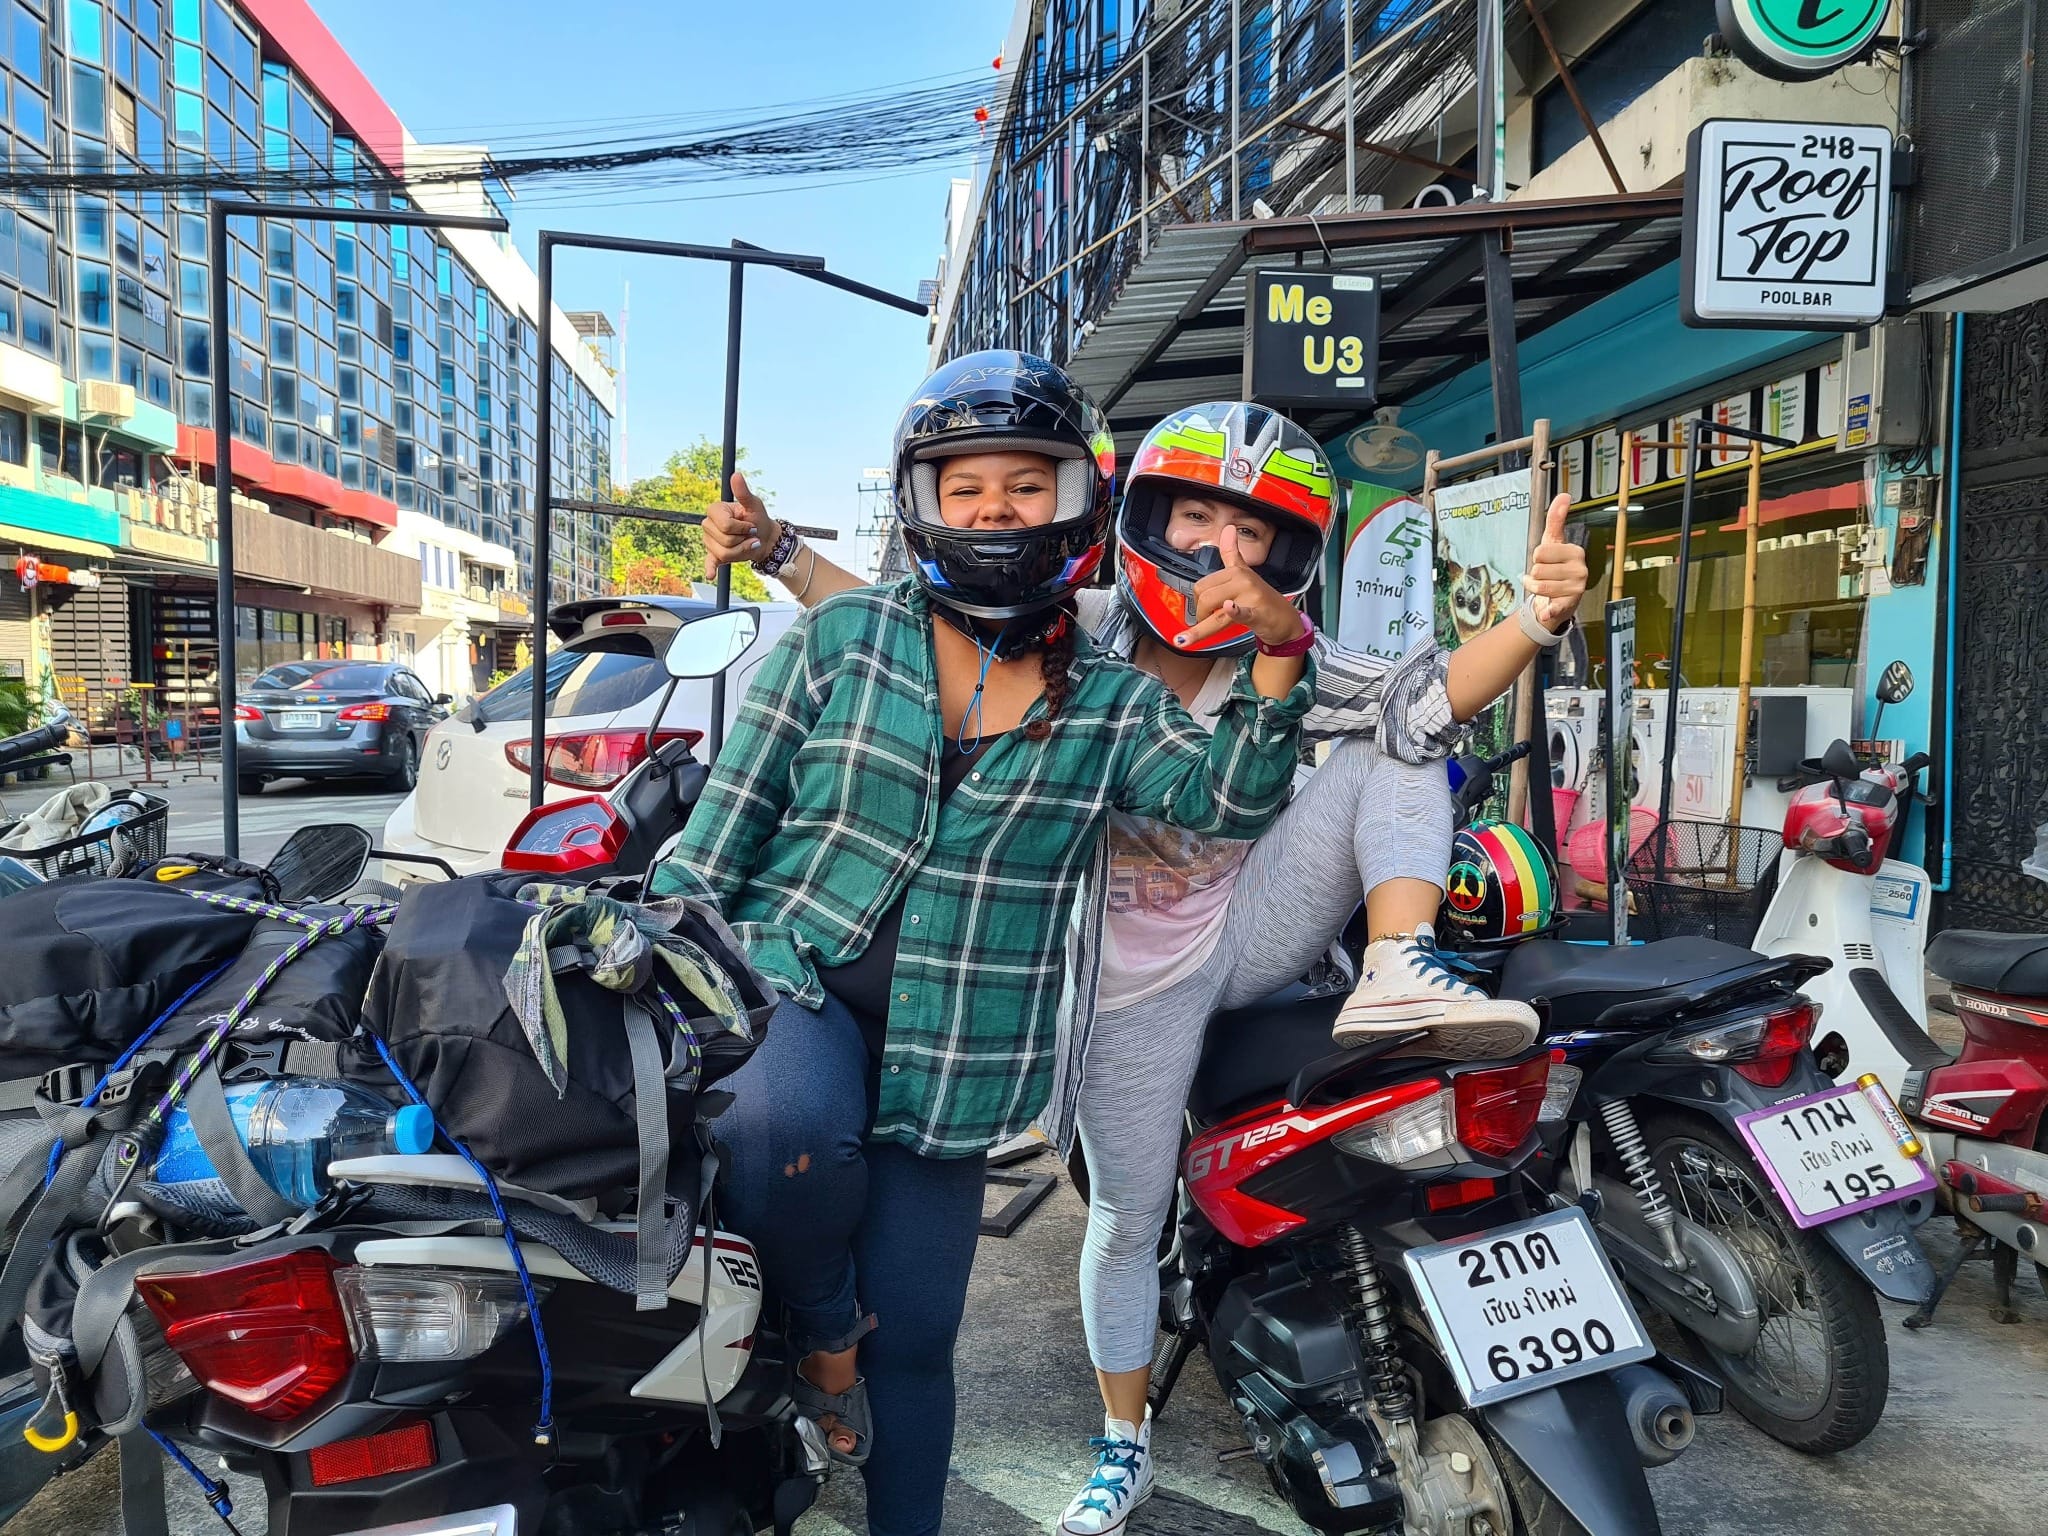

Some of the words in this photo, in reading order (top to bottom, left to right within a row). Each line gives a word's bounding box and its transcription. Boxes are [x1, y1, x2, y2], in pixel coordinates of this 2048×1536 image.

[1801, 135, 1855, 159] 248
[1724, 156, 1876, 220] Roof
[1738, 213, 1850, 281] Top
[1268, 283, 1333, 326] Me
[1303, 335, 1365, 376] U3
[1575, 720, 1583, 735] 5
[1646, 723, 1653, 738] 1
[1685, 776, 1705, 805] 50
[1887, 889, 1912, 902] 2560
[1965, 998, 2010, 1018] HONDA
[1780, 1096, 1857, 1143] 1กม
[1972, 1113, 1990, 1124] 100
[1800, 1131, 1875, 1173] เชียงใหม่
[1823, 1163, 1896, 1207] 195
[717, 1254, 761, 1292] 125
[1484, 1277, 1578, 1327] เชียงใหม่
[1486, 1317, 1616, 1383] 6390
